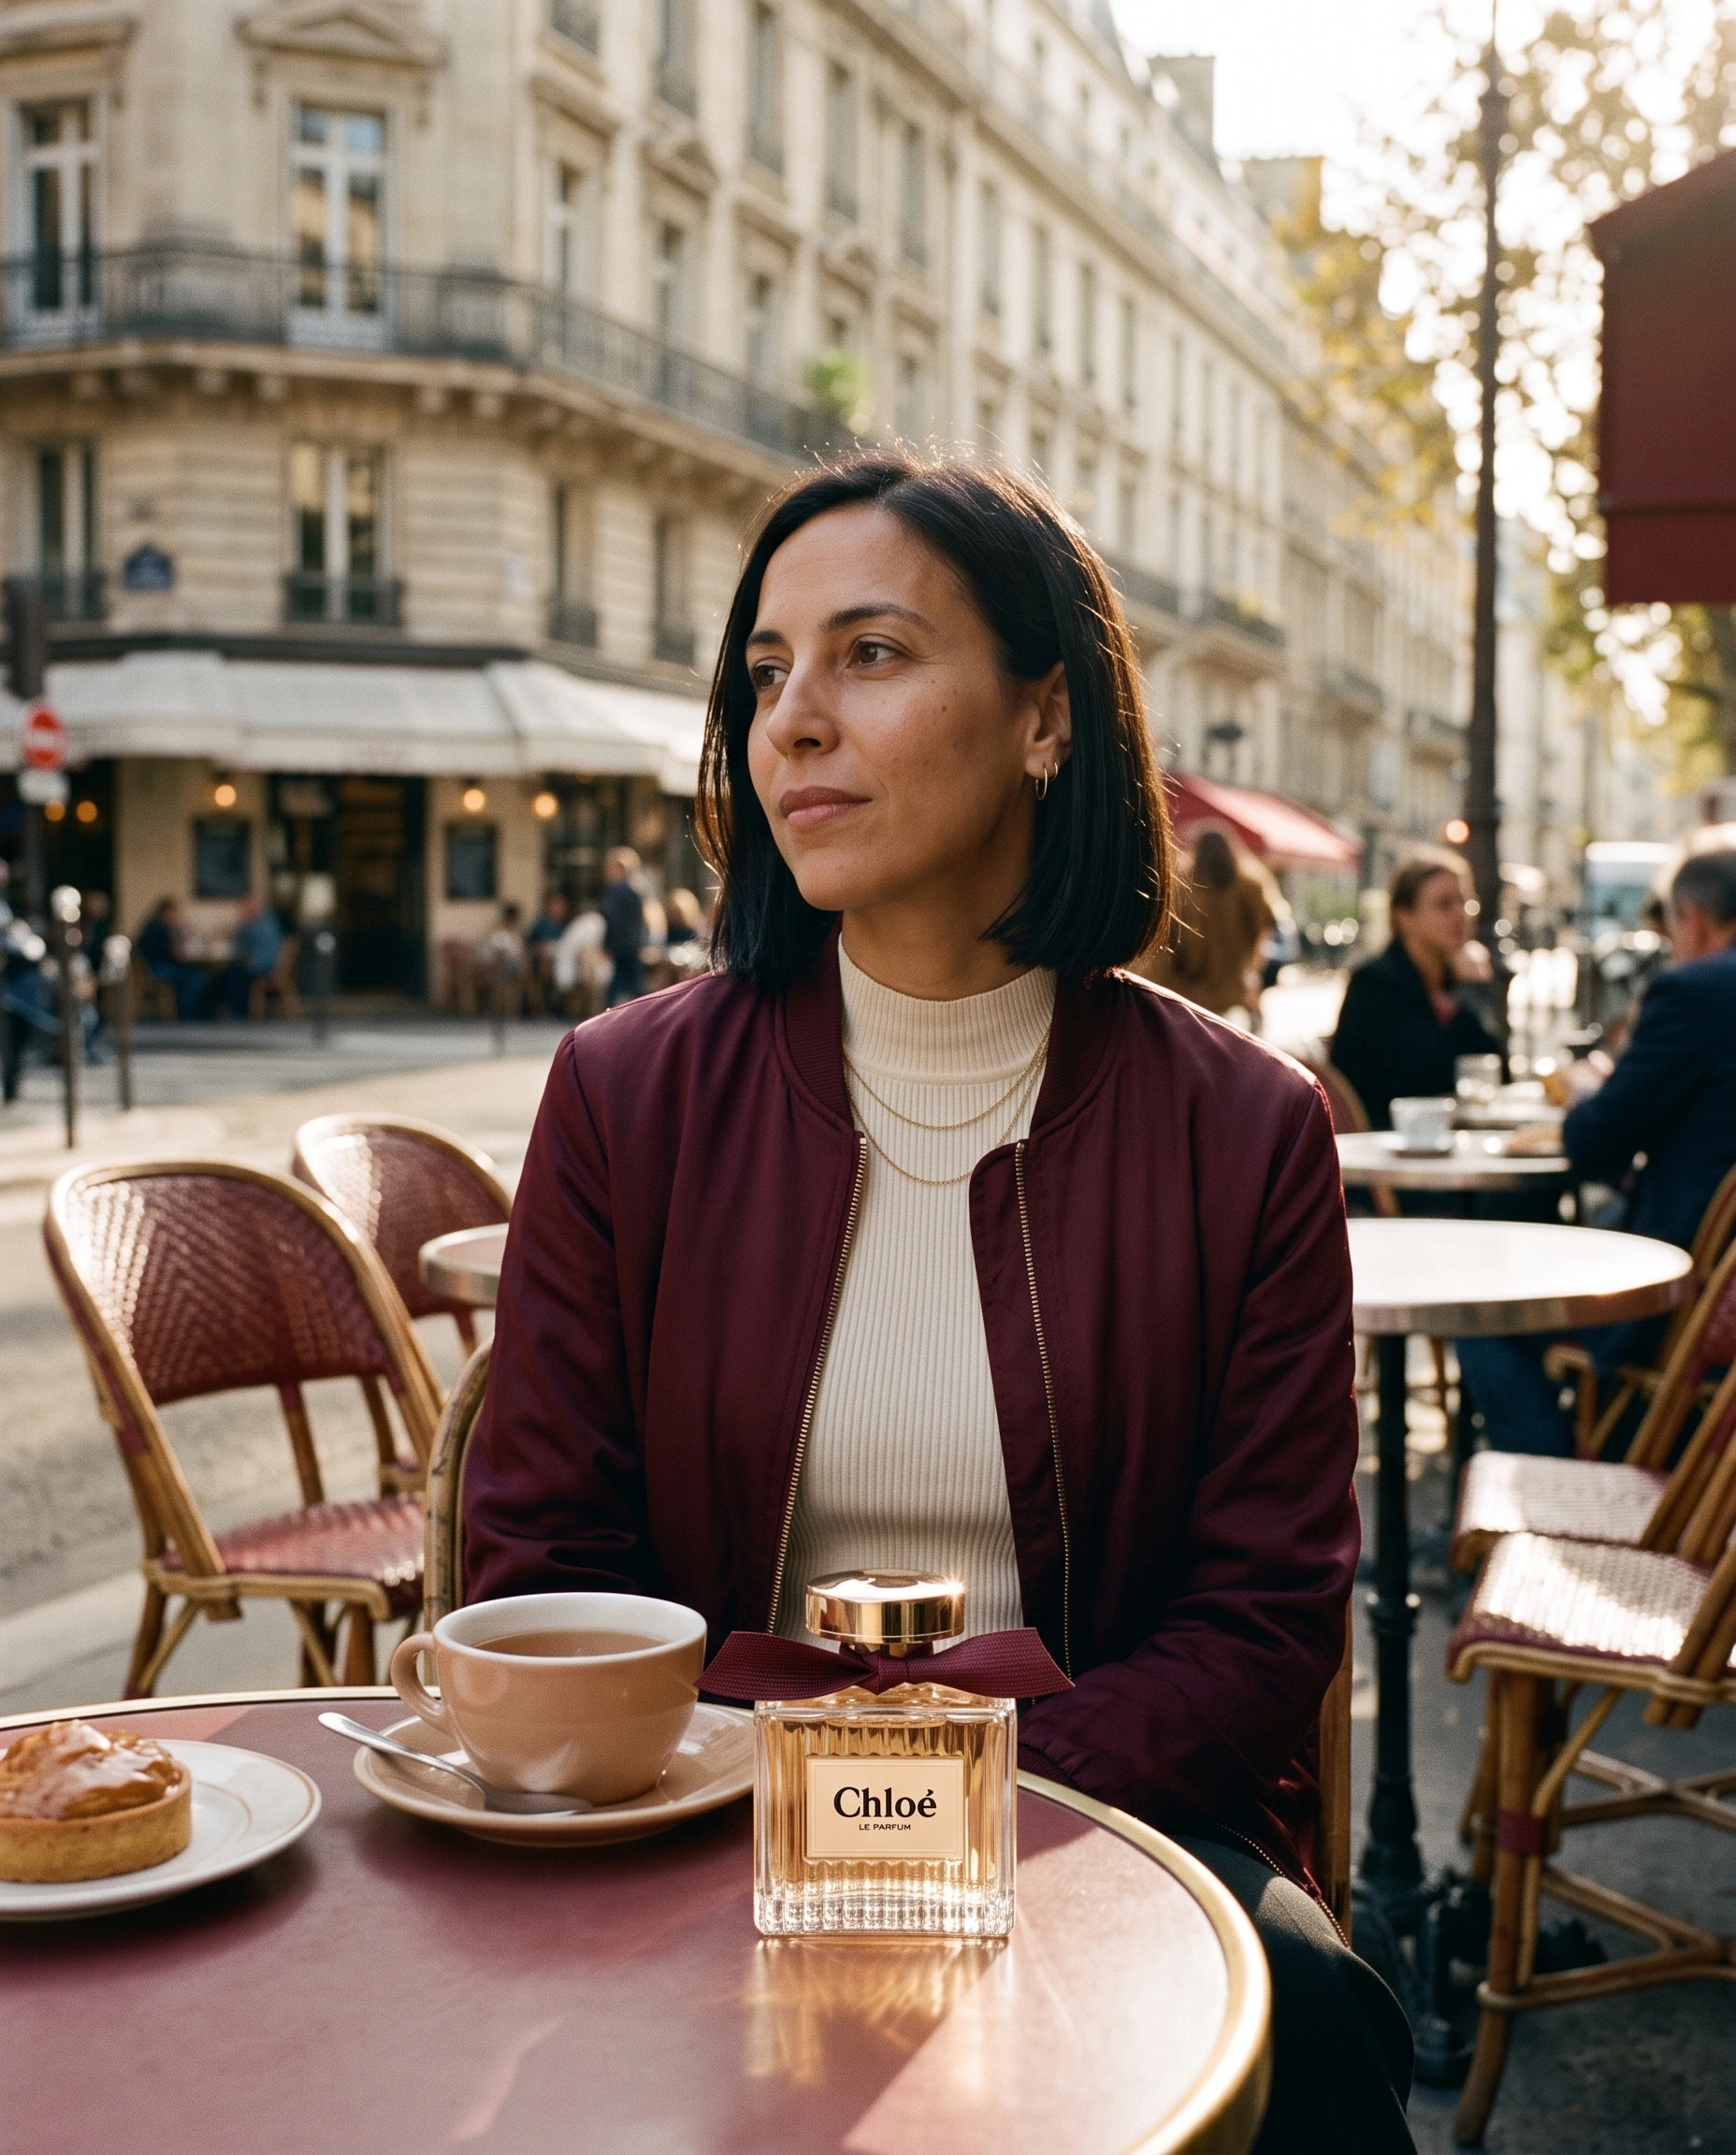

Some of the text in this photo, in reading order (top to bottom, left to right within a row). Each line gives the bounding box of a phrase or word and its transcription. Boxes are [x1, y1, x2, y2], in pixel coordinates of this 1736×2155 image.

[833, 1786, 937, 1818] Chloé
[859, 1823, 911, 1831] LE PARFUM
